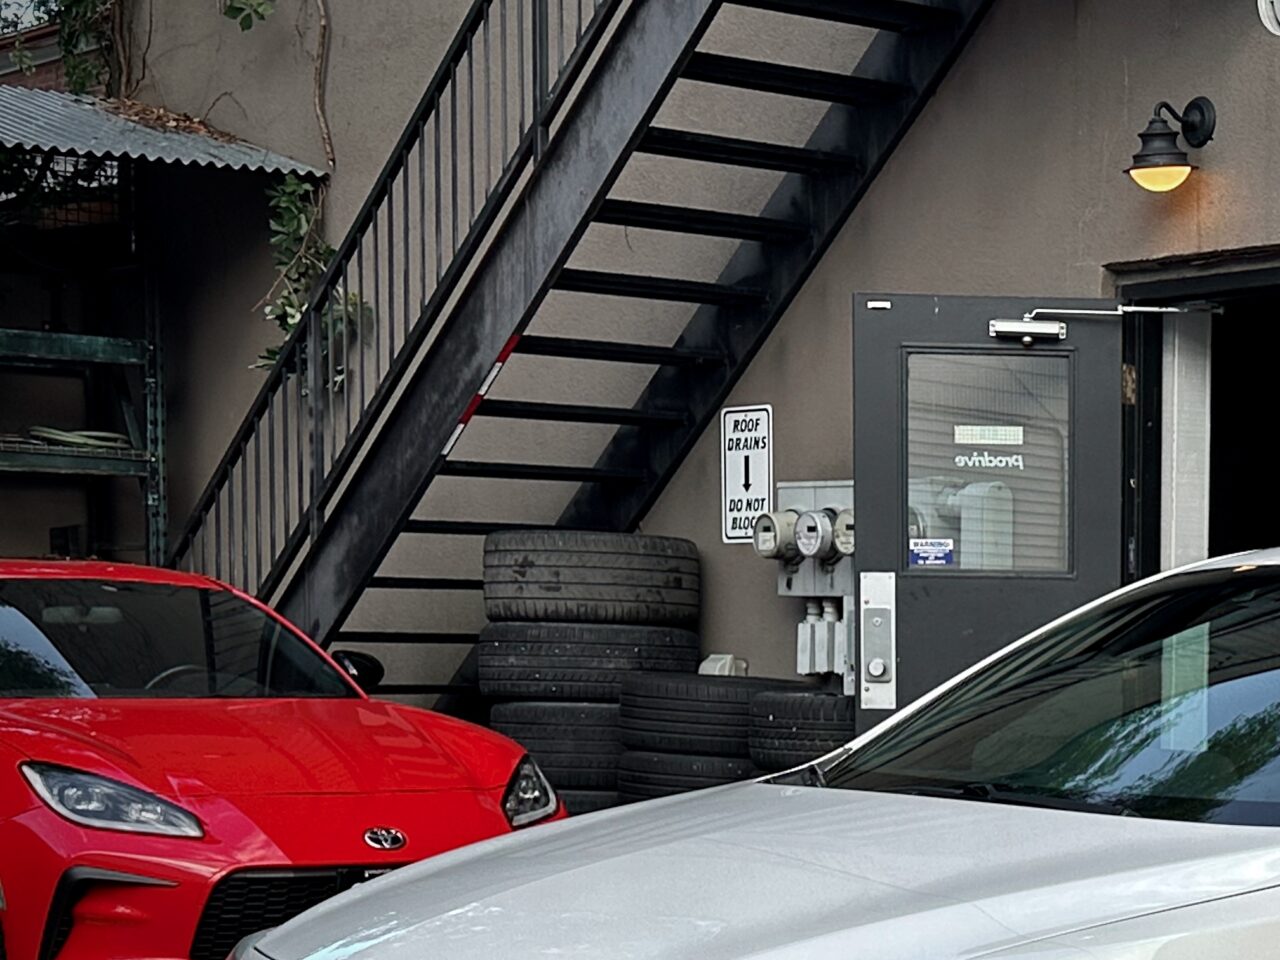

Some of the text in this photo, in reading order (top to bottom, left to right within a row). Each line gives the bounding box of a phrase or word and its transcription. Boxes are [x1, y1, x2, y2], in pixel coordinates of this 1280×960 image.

[732, 418, 761, 434] ROOF
[727, 436, 767, 451] DRAINS
[728, 498, 766, 512] DO NOT
[731, 516, 756, 530] BLOC
